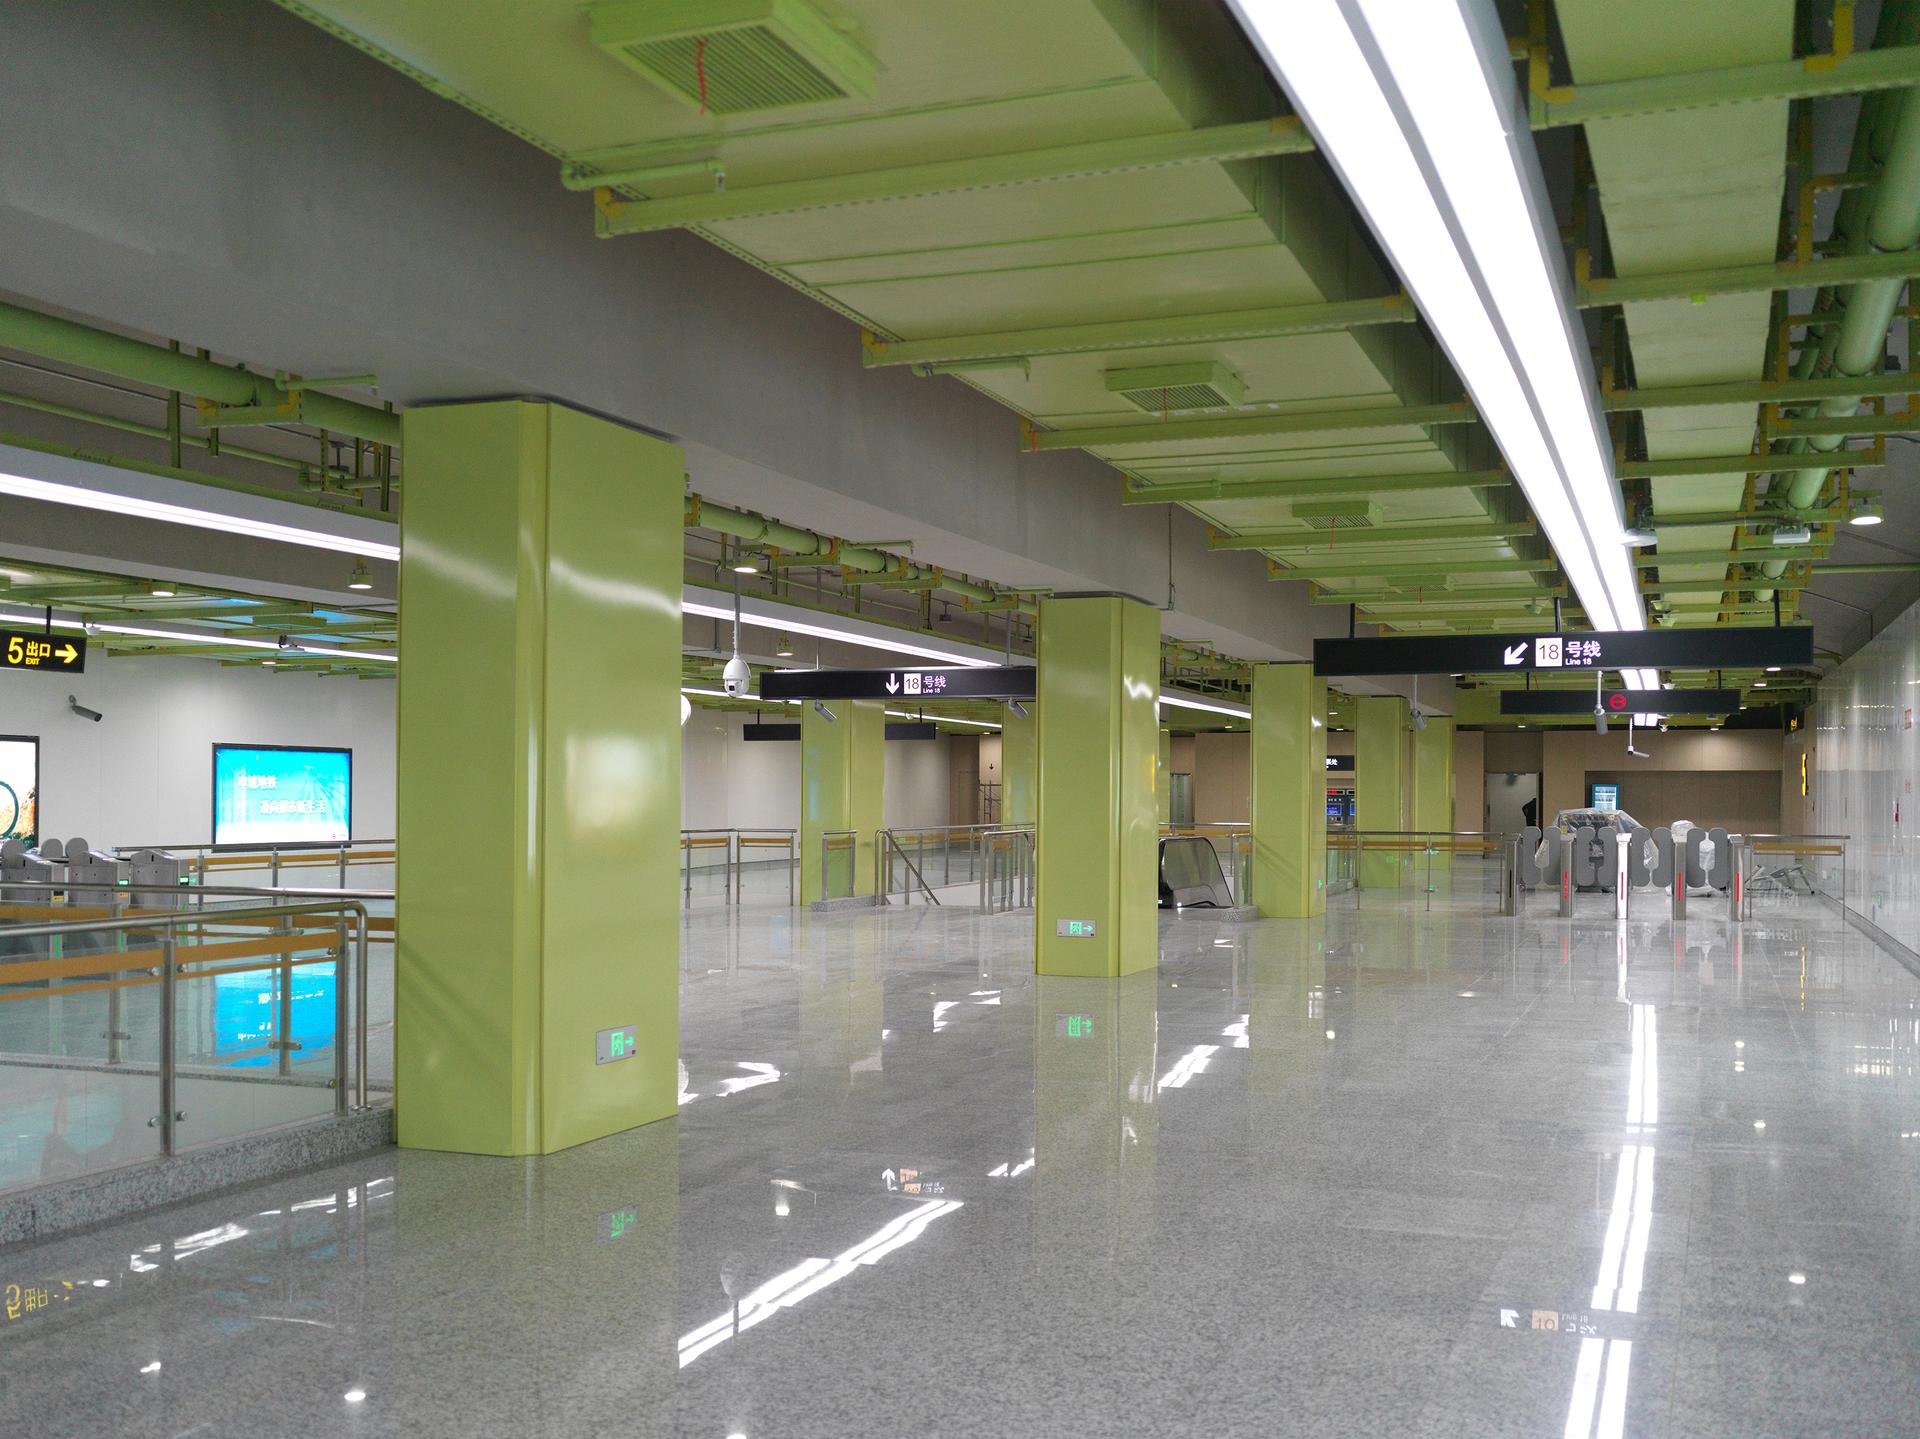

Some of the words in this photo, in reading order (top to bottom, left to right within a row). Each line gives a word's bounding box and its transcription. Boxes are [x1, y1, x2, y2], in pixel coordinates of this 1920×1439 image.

[8, 636, 24, 664] 5
[26, 641, 51, 657] 出口
[1539, 644, 1559, 660] 18
[1565, 640, 1601, 658] 号线
[25, 657, 40, 665] EXIT
[1565, 658, 1581, 666] Line
[905, 678, 919, 689] 18
[923, 675, 946, 688] 号线
